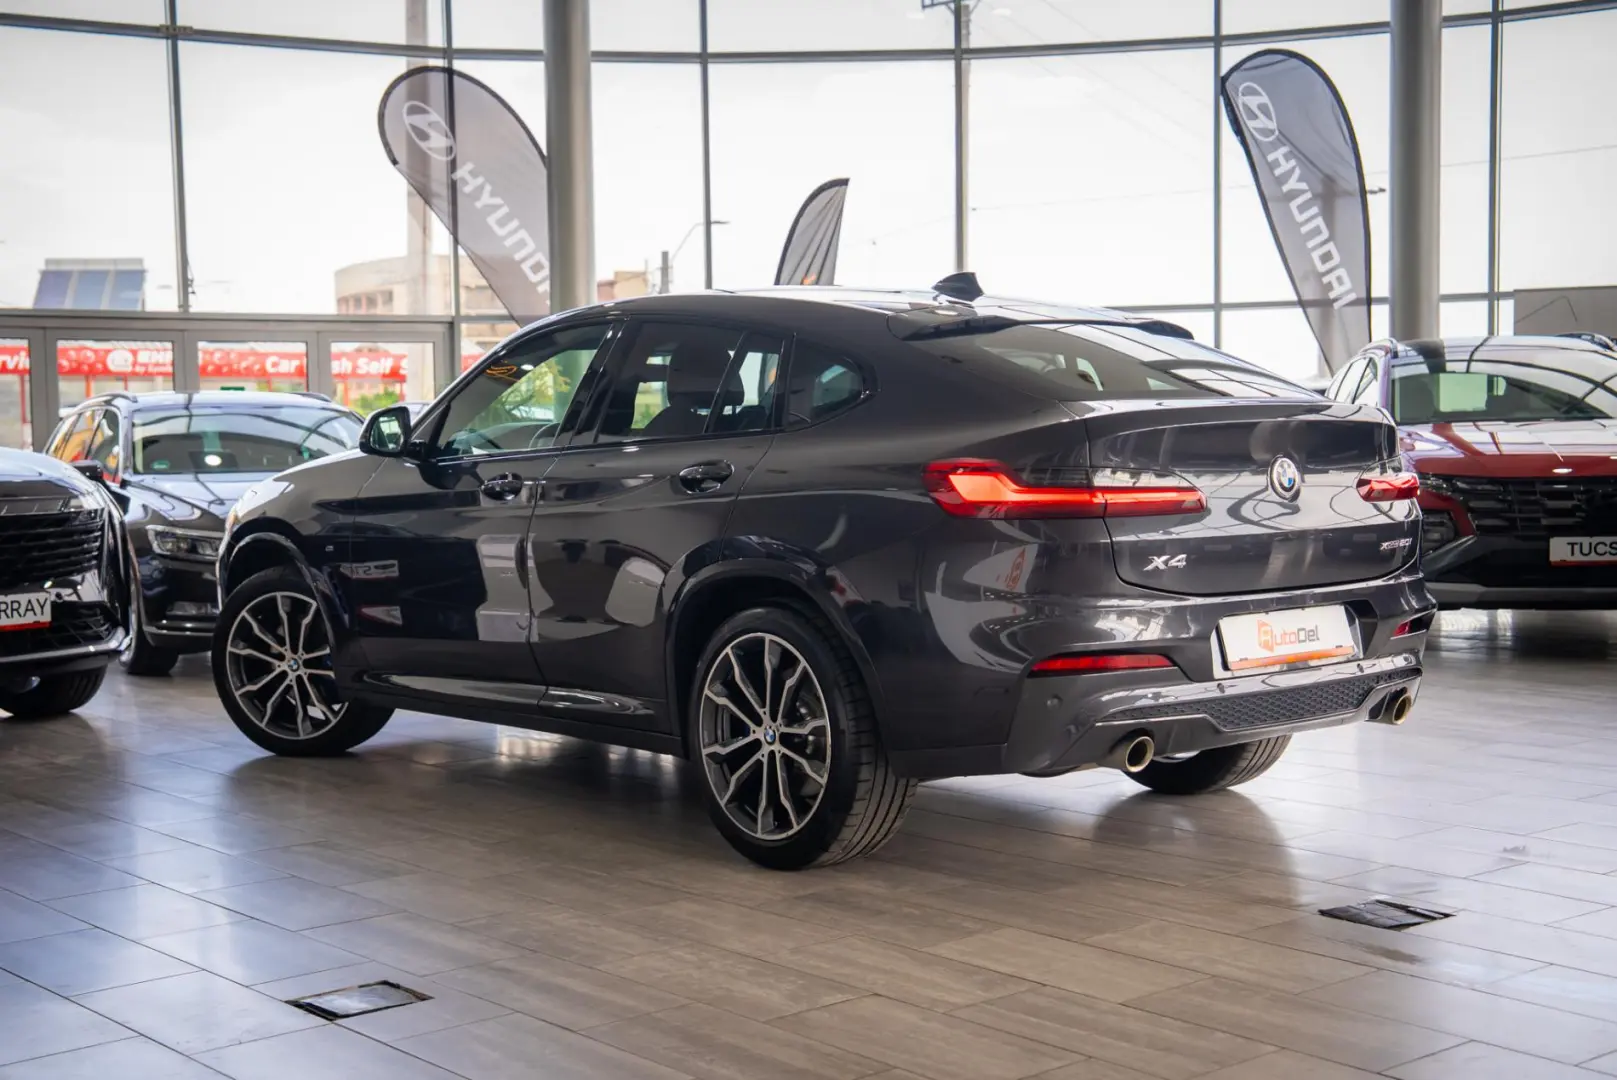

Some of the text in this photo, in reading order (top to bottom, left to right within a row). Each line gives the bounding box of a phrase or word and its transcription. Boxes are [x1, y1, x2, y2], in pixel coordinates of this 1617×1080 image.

[451, 161, 550, 306] HYUND
[1267, 146, 1358, 310] HYUNDAI
[265, 355, 301, 374] Car
[356, 357, 394, 375] Self
[1566, 541, 1617, 557] TUCS
[1143, 553, 1188, 571] X4
[0, 597, 48, 620] RRAY
